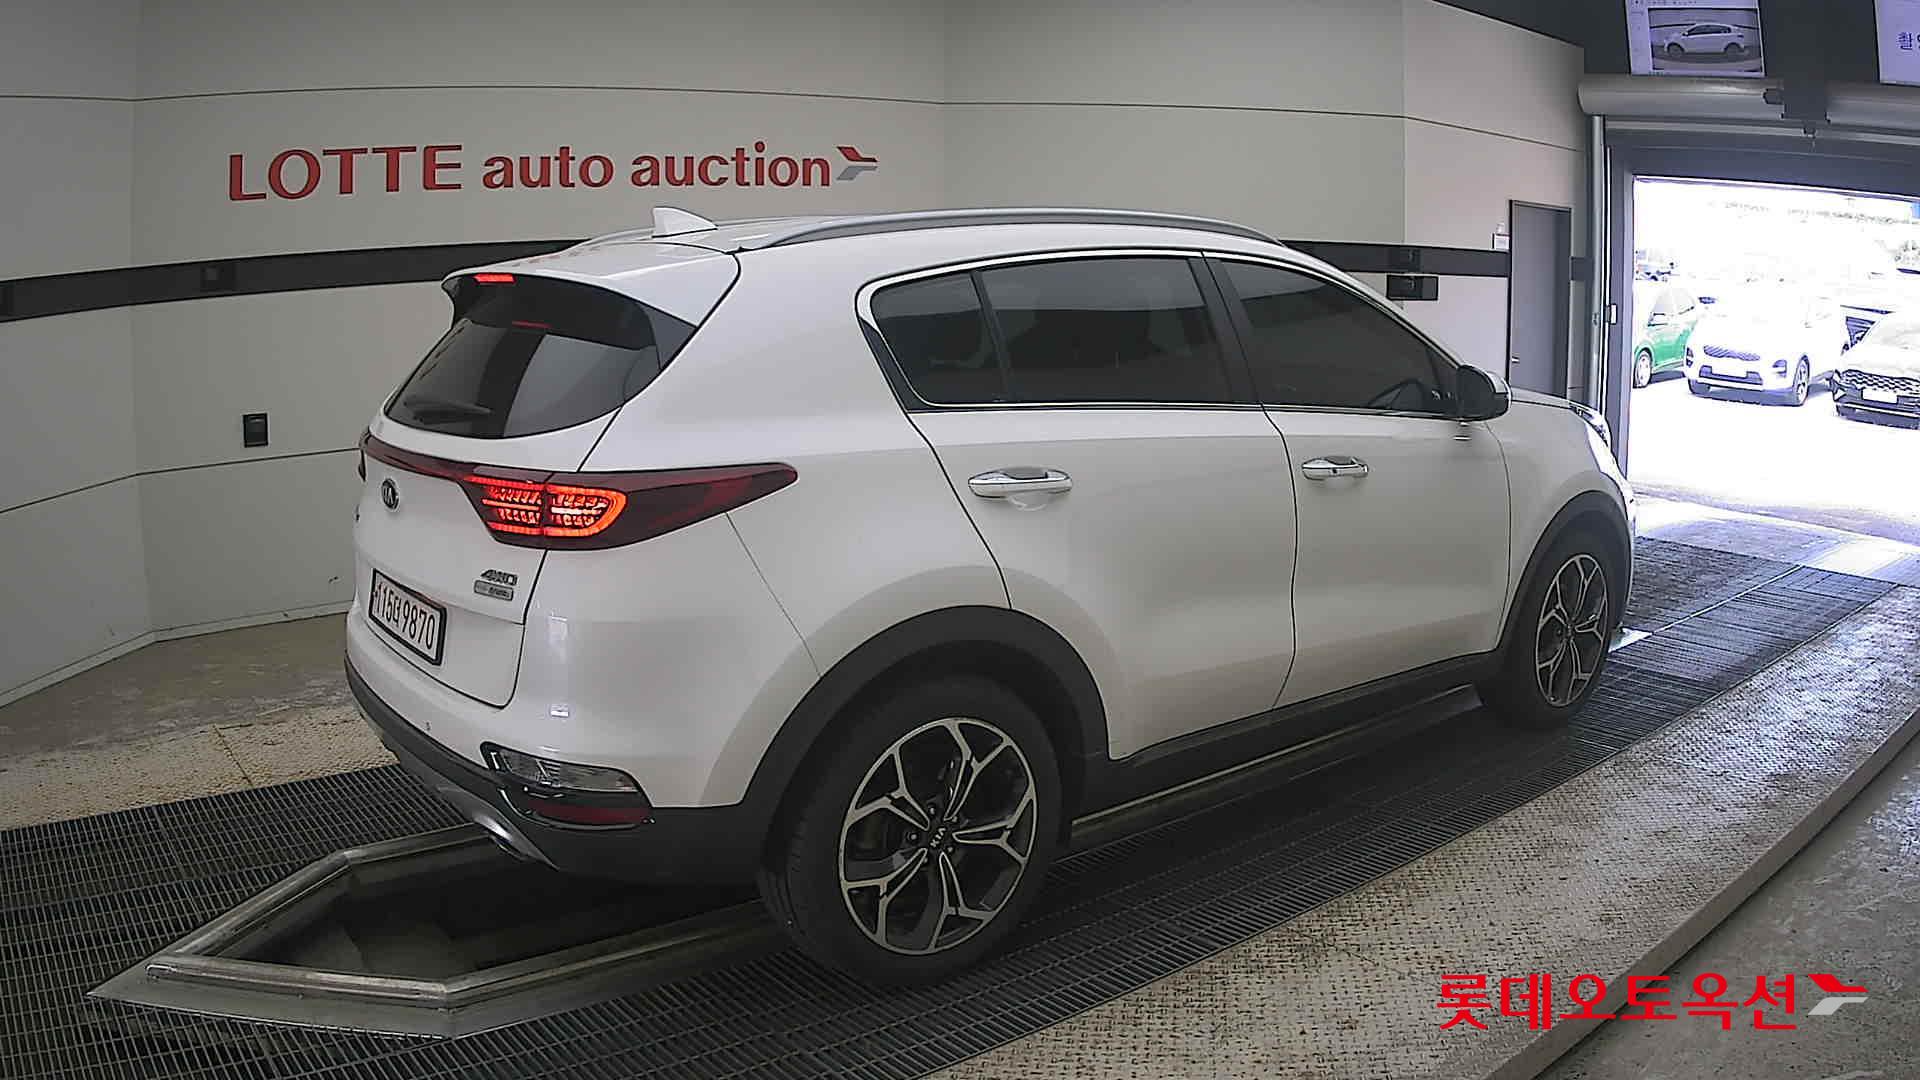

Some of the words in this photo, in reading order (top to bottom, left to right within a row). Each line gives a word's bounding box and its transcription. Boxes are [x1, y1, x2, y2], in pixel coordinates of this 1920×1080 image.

[228, 144, 463, 201] LOTTE
[481, 144, 614, 190] auto
[630, 140, 832, 188] auction
[929, 827, 947, 848] KIA
